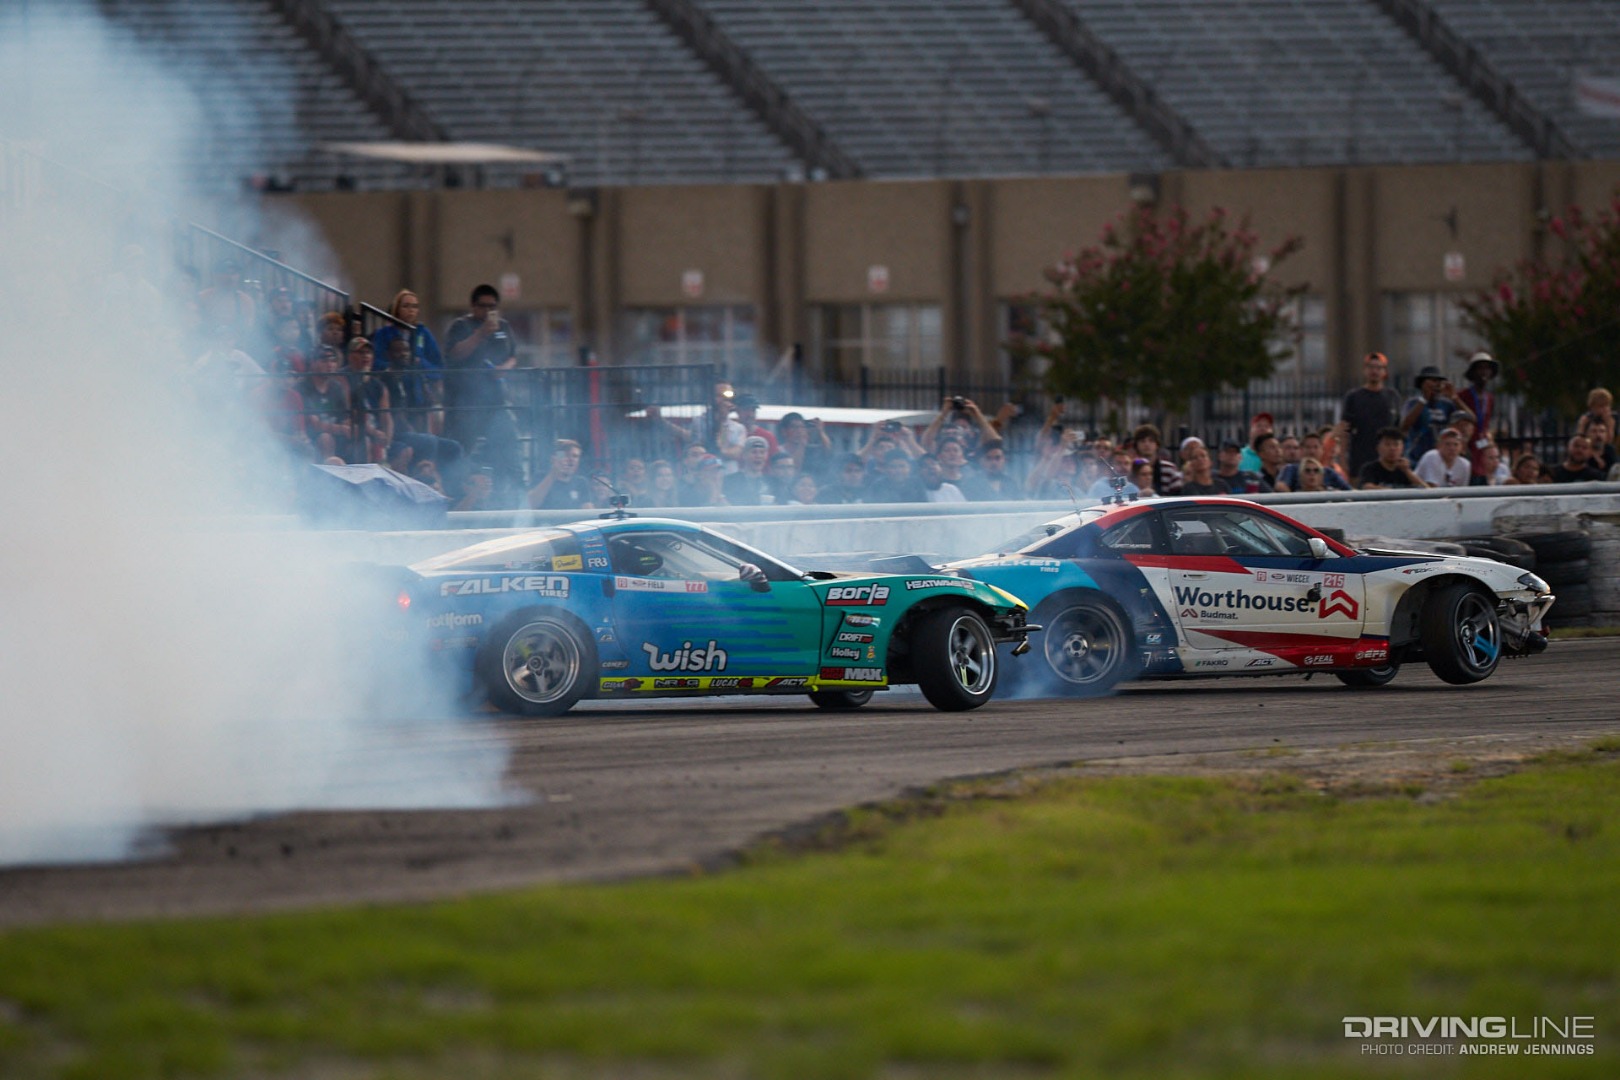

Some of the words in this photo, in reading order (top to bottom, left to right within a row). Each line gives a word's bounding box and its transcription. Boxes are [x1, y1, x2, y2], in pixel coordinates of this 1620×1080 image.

[441, 576, 569, 596] FALKEN
[1324, 574, 1344, 587] 215
[1175, 586, 1315, 613] Worthouse.
[643, 640, 727, 671] wish
[832, 647, 860, 660] Holley
[844, 667, 882, 681] MAX
[709, 679, 738, 687] LUCAS
